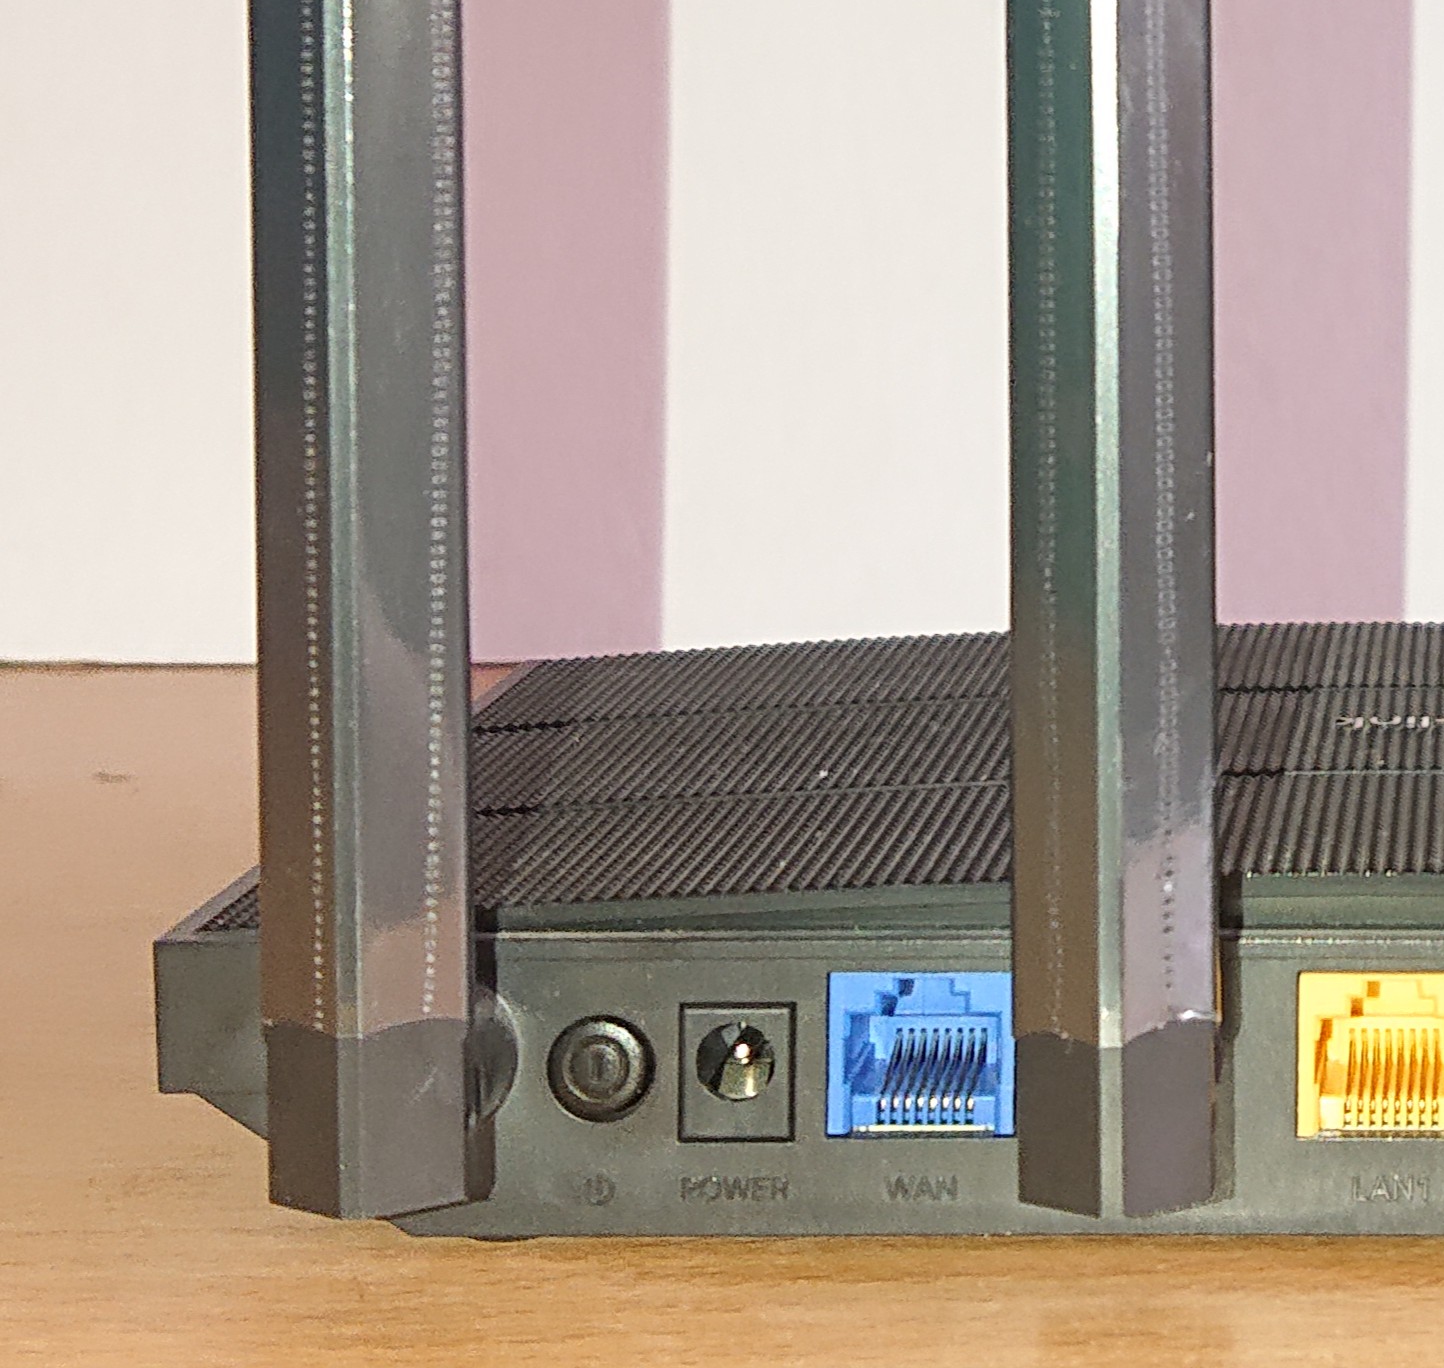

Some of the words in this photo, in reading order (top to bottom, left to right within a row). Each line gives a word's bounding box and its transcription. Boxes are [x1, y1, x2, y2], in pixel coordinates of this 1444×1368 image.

[680, 1174, 789, 1202] POWER
[885, 1174, 959, 1201] WAN
[1351, 1174, 1431, 1203] LAN1
